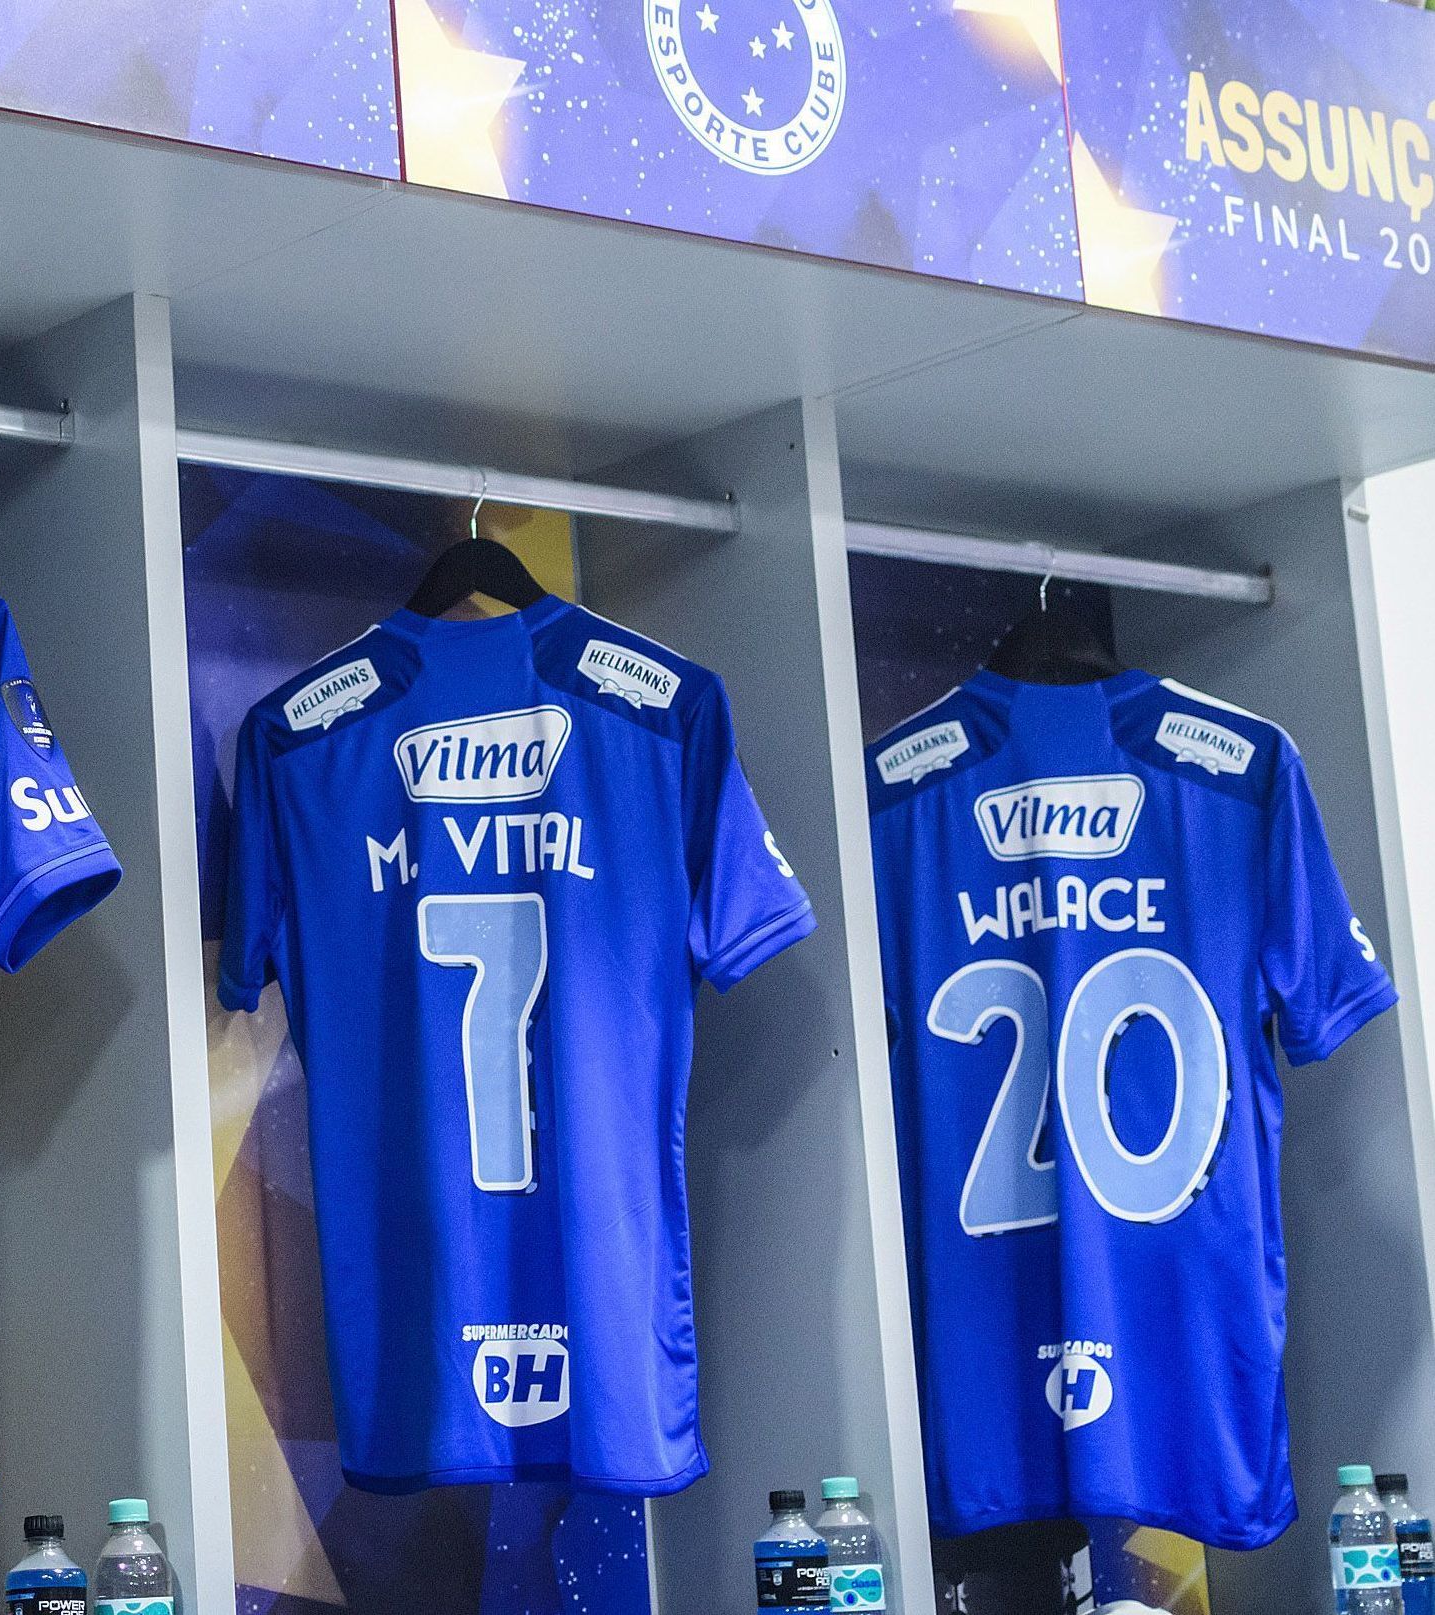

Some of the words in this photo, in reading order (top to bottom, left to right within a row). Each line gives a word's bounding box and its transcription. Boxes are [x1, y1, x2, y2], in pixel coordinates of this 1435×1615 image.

[654, 5, 770, 162] ESPORTE
[784, 42, 835, 155] CLUBE
[1185, 70, 1435, 222] ASSUNÇ
[1224, 195, 1361, 262] FINAL
[406, 734, 546, 786] Vilma
[10, 776, 92, 832] Su
[990, 795, 1119, 844] Vilma
[366, 828, 419, 893] M.
[443, 811, 595, 880] VITAL
[958, 874, 1166, 946] WALACE
[417, 892, 548, 1192] 7
[926, 947, 1228, 1236] 20
[484, 1354, 566, 1404] BH
[38, 1600, 85, 1611] POWER
[796, 1567, 830, 1578] POWE
